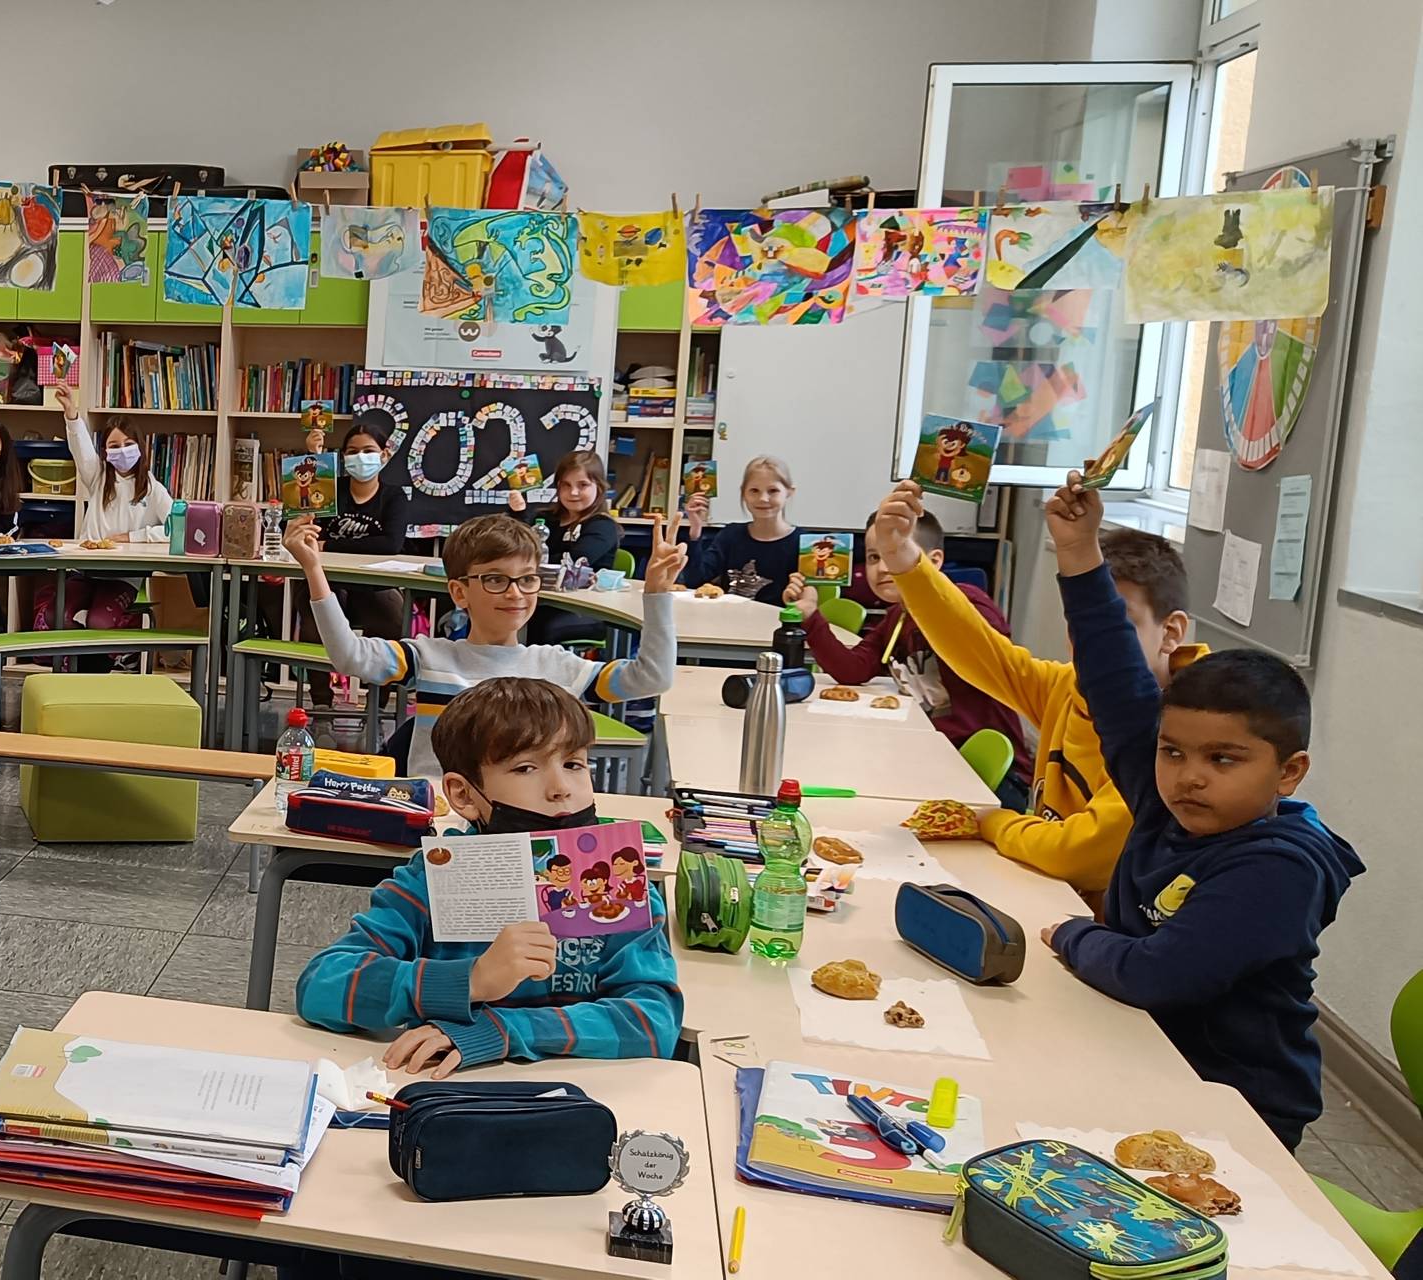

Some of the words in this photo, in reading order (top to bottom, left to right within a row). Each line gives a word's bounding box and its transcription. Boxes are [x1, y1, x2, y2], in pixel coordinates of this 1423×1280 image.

[324, 777, 350, 790] Harry
[350, 782, 382, 793] Potter
[643, 1161, 658, 1169] der
[637, 1170, 664, 1181] Woche
